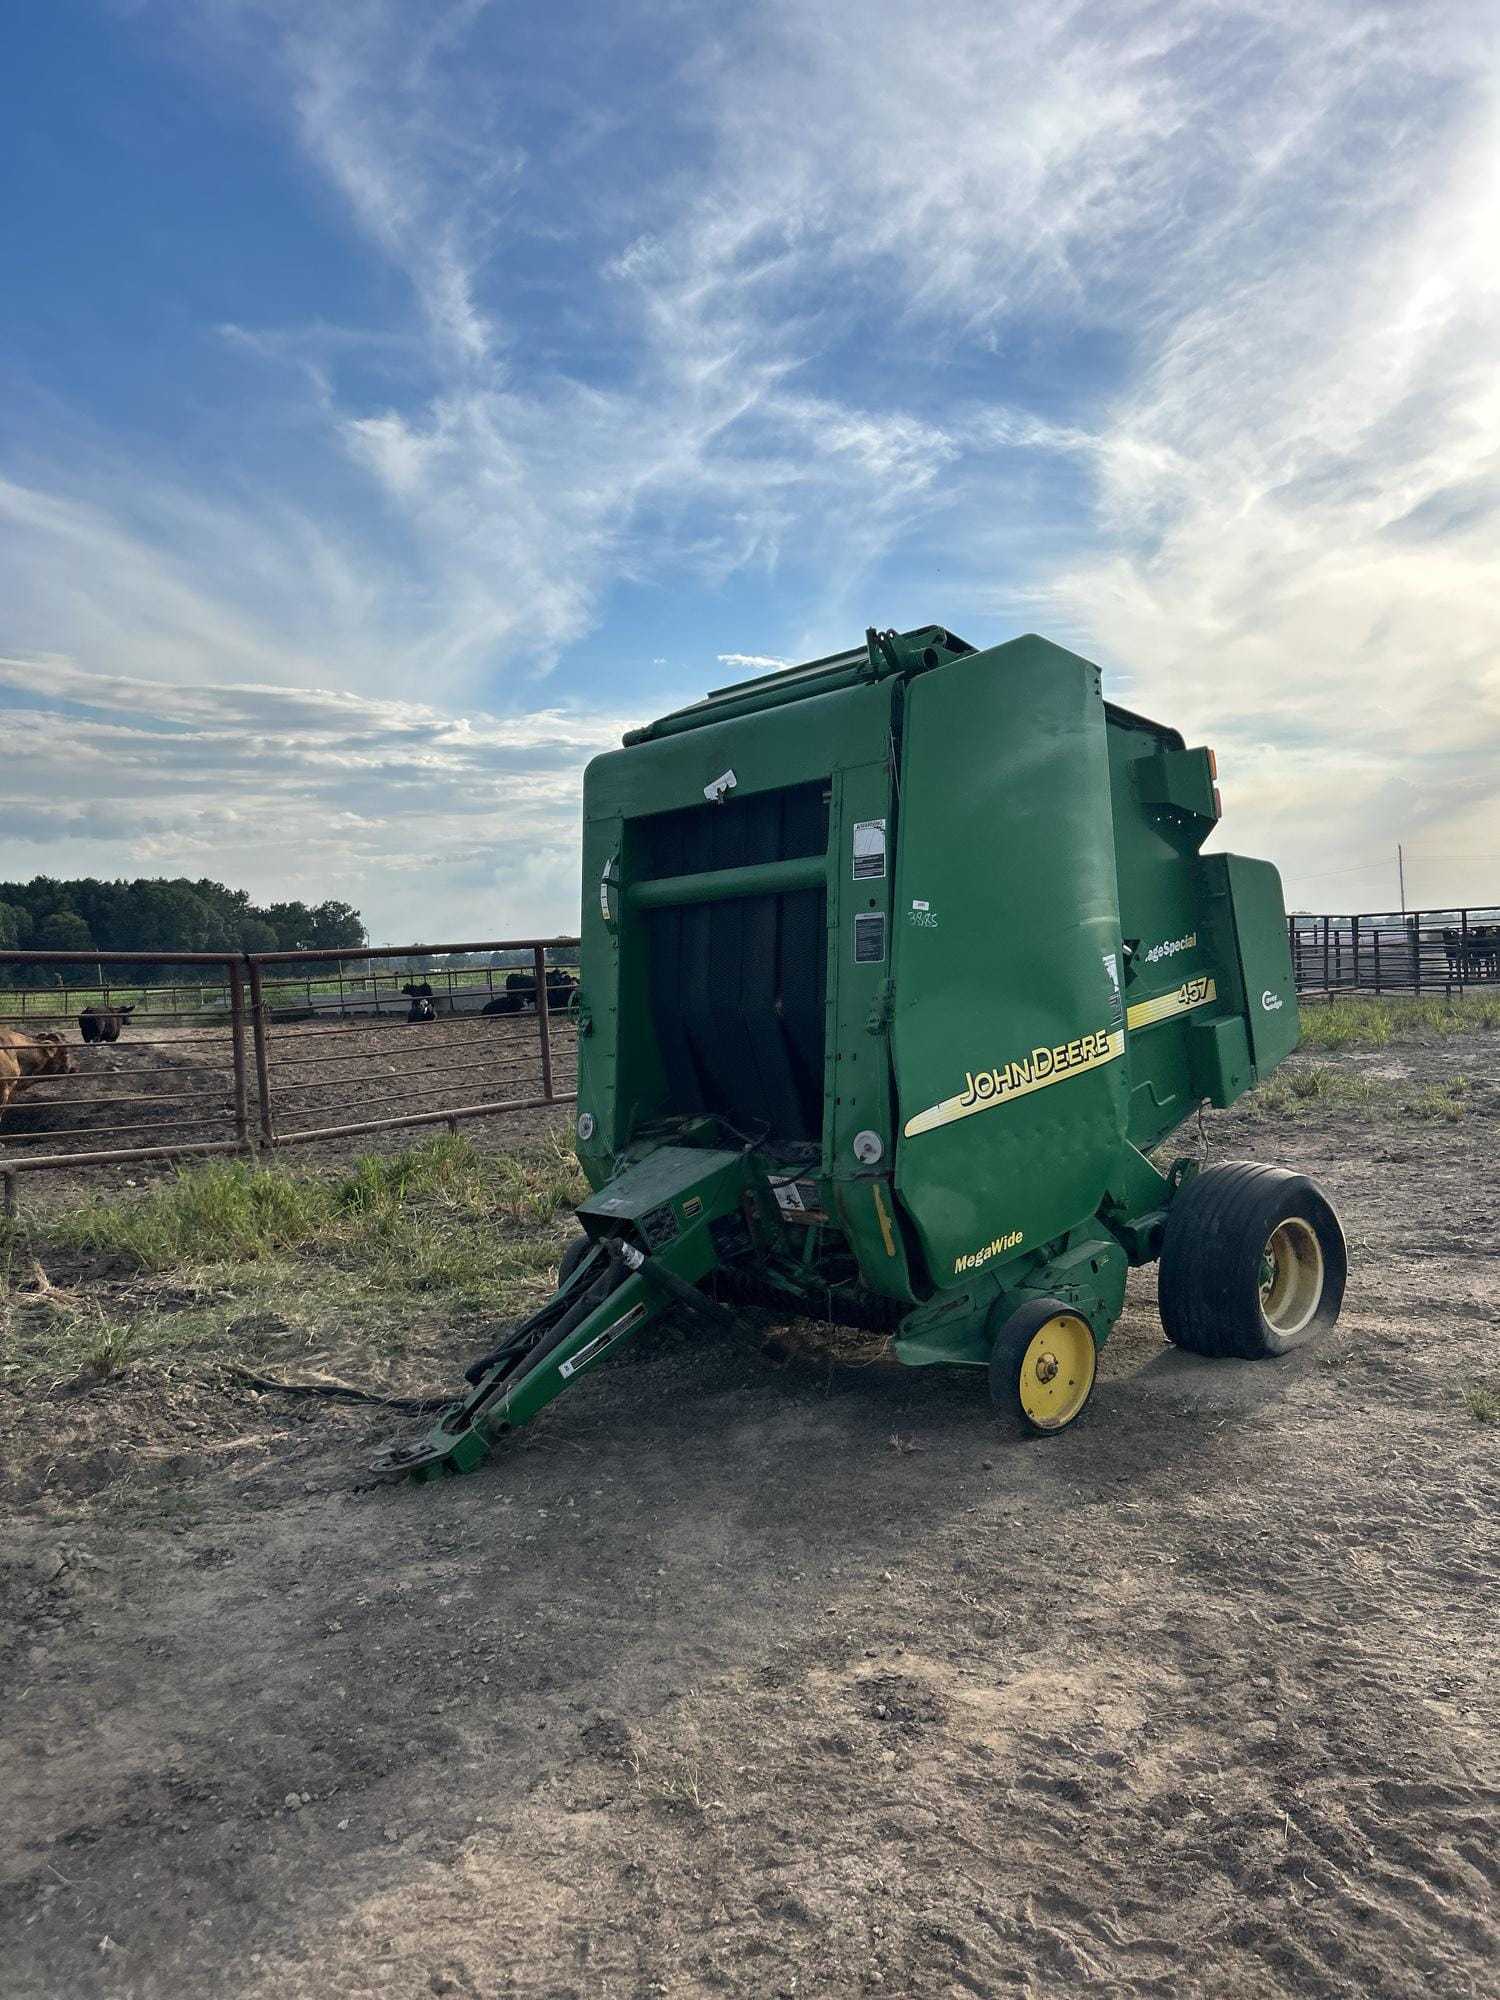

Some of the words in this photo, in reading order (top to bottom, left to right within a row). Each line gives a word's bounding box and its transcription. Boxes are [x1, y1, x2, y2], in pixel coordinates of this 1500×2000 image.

[1145, 932, 1197, 963] ageSpecial
[1177, 976, 1209, 1005] 457
[954, 1231, 1024, 1274] MegaWide
